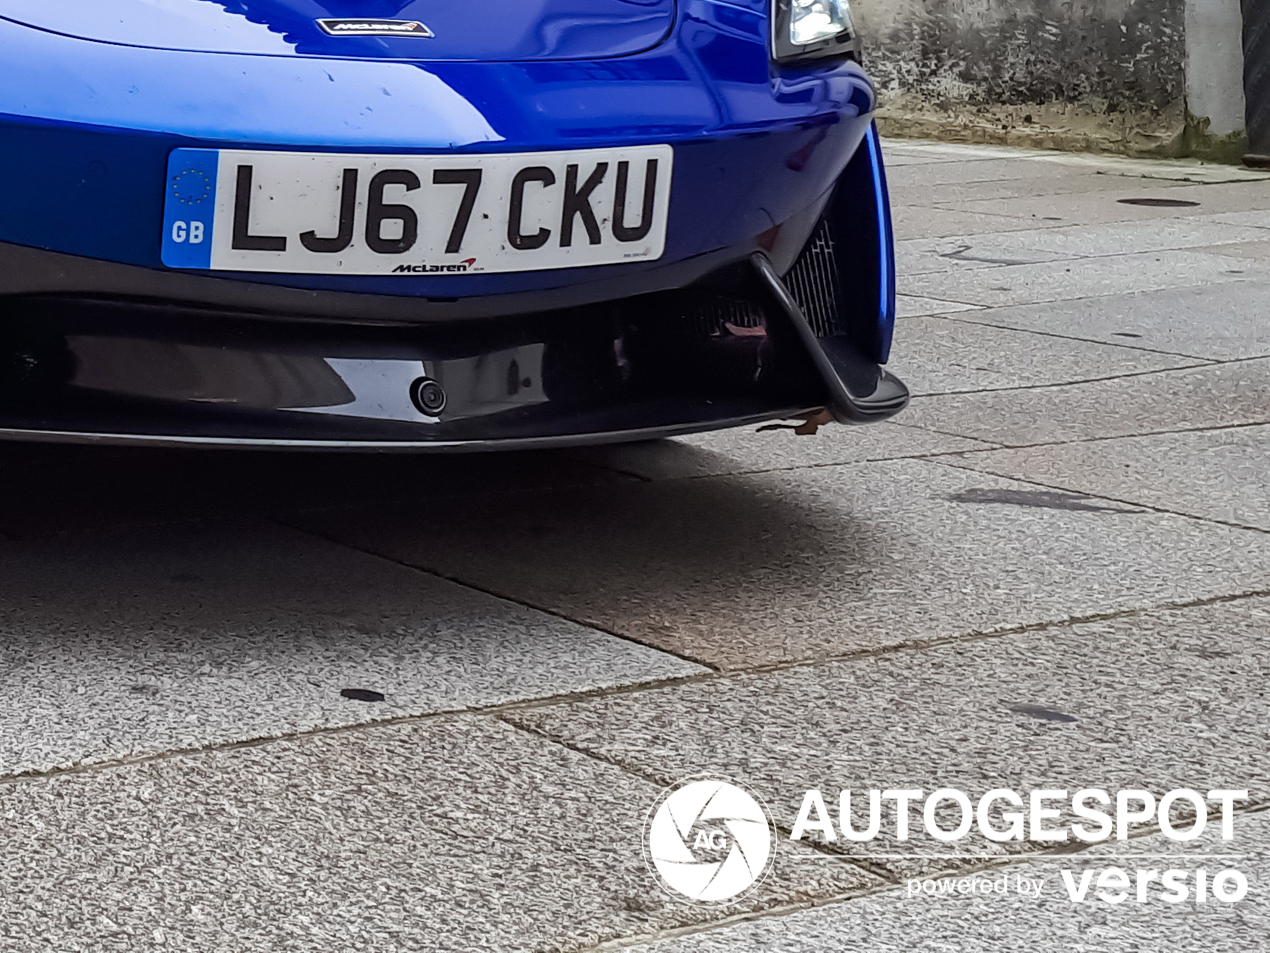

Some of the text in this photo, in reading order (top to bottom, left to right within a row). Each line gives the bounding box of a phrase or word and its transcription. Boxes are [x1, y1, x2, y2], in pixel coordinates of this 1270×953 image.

[231, 158, 659, 254] LJ67 CKU
[171, 220, 205, 244] GB
[391, 264, 467, 273] McLaren
